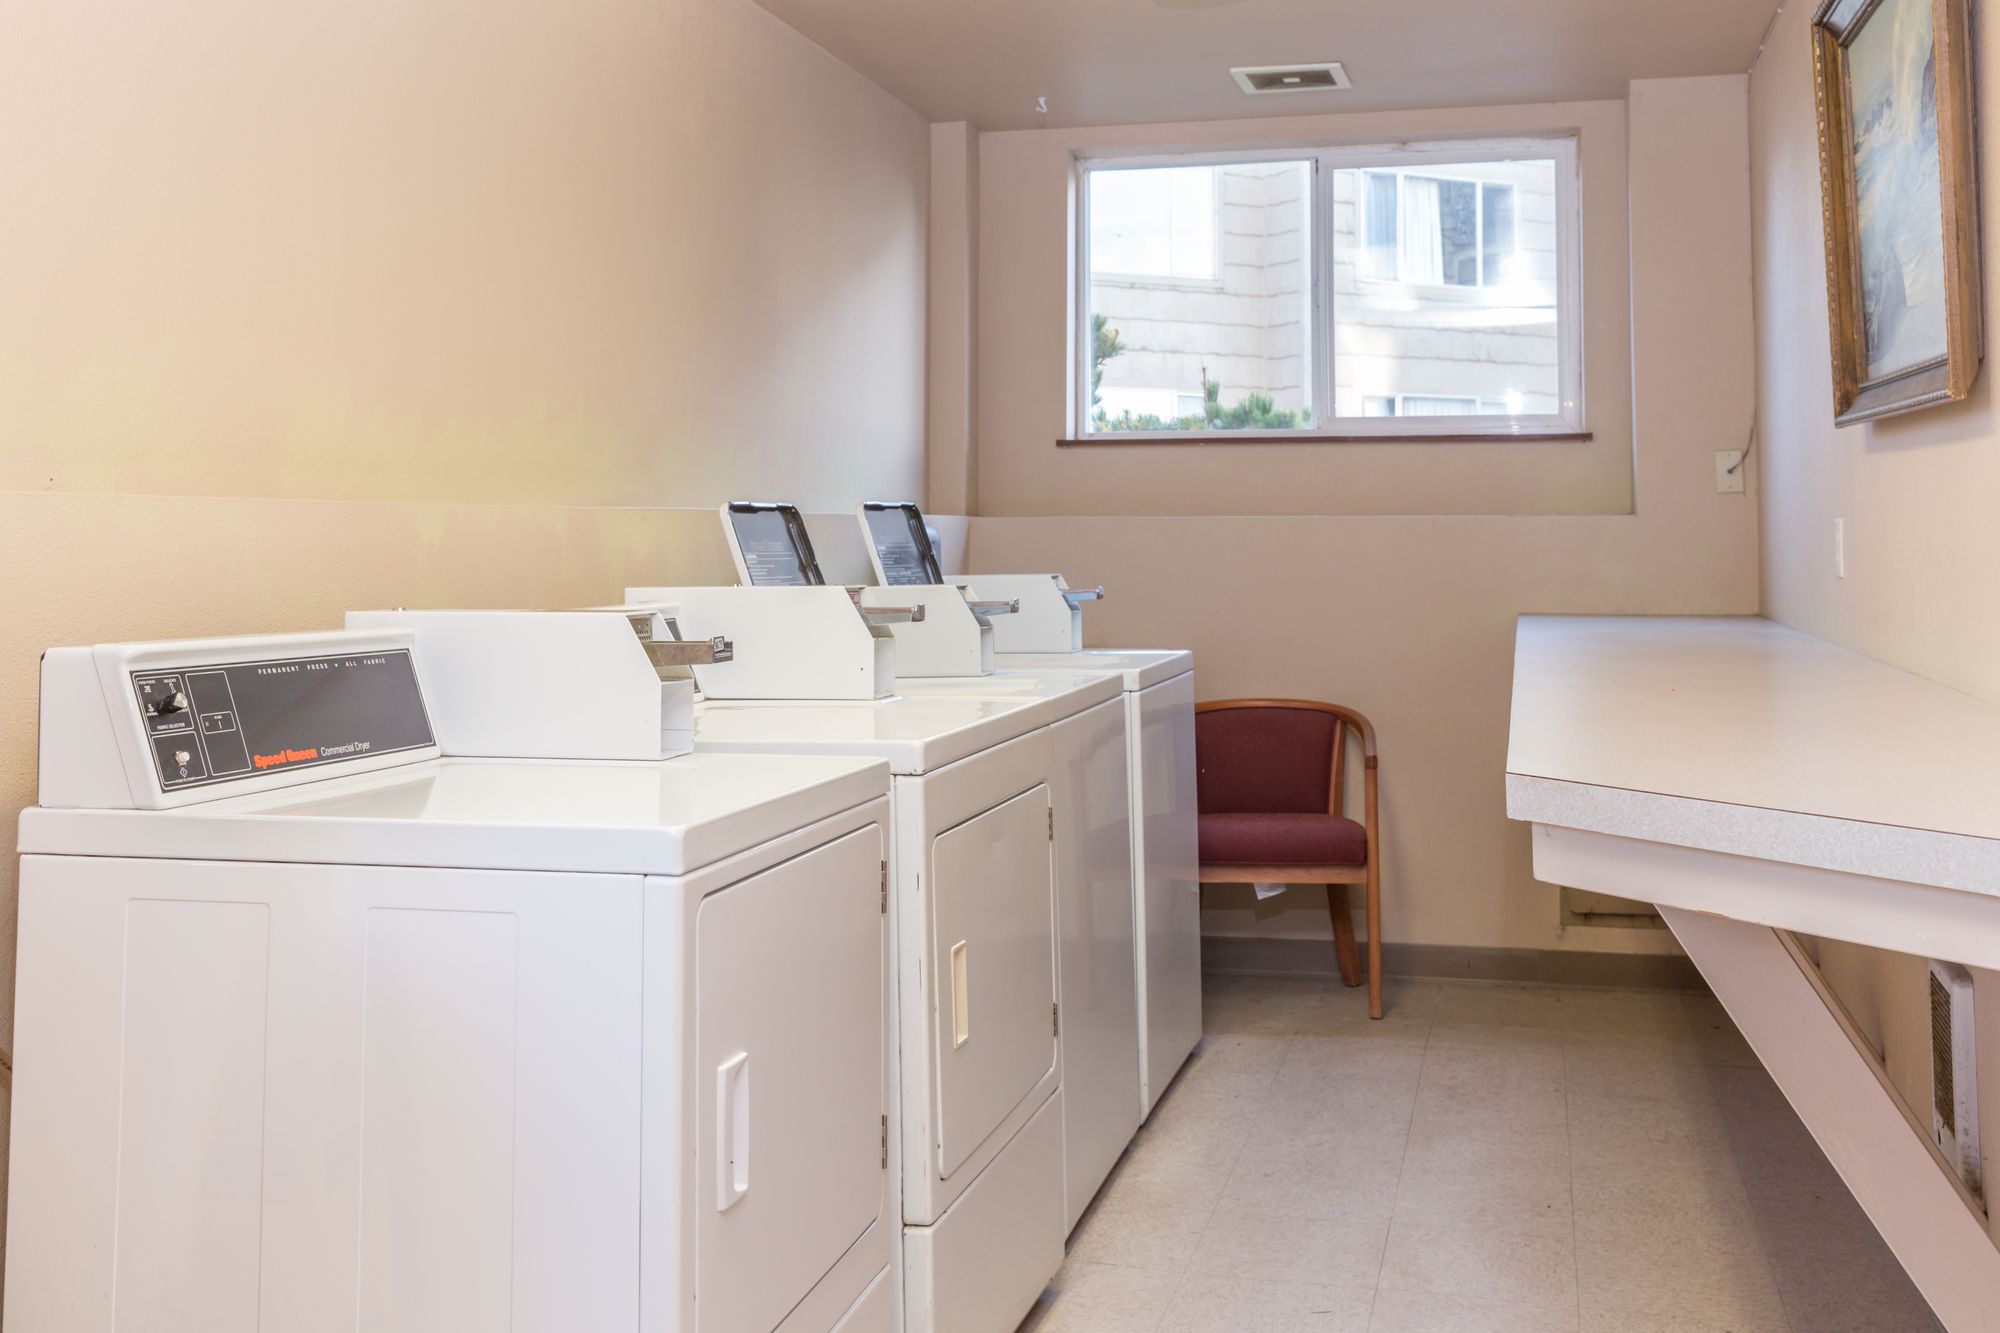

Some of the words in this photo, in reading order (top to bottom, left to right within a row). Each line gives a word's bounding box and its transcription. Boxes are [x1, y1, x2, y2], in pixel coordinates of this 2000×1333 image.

[257, 665, 300, 675] PERMANENT
[253, 750, 287, 769] Speed
[286, 747, 318, 762] Queen
[320, 743, 355, 757] Commercial
[355, 741, 370, 753] Dryer
